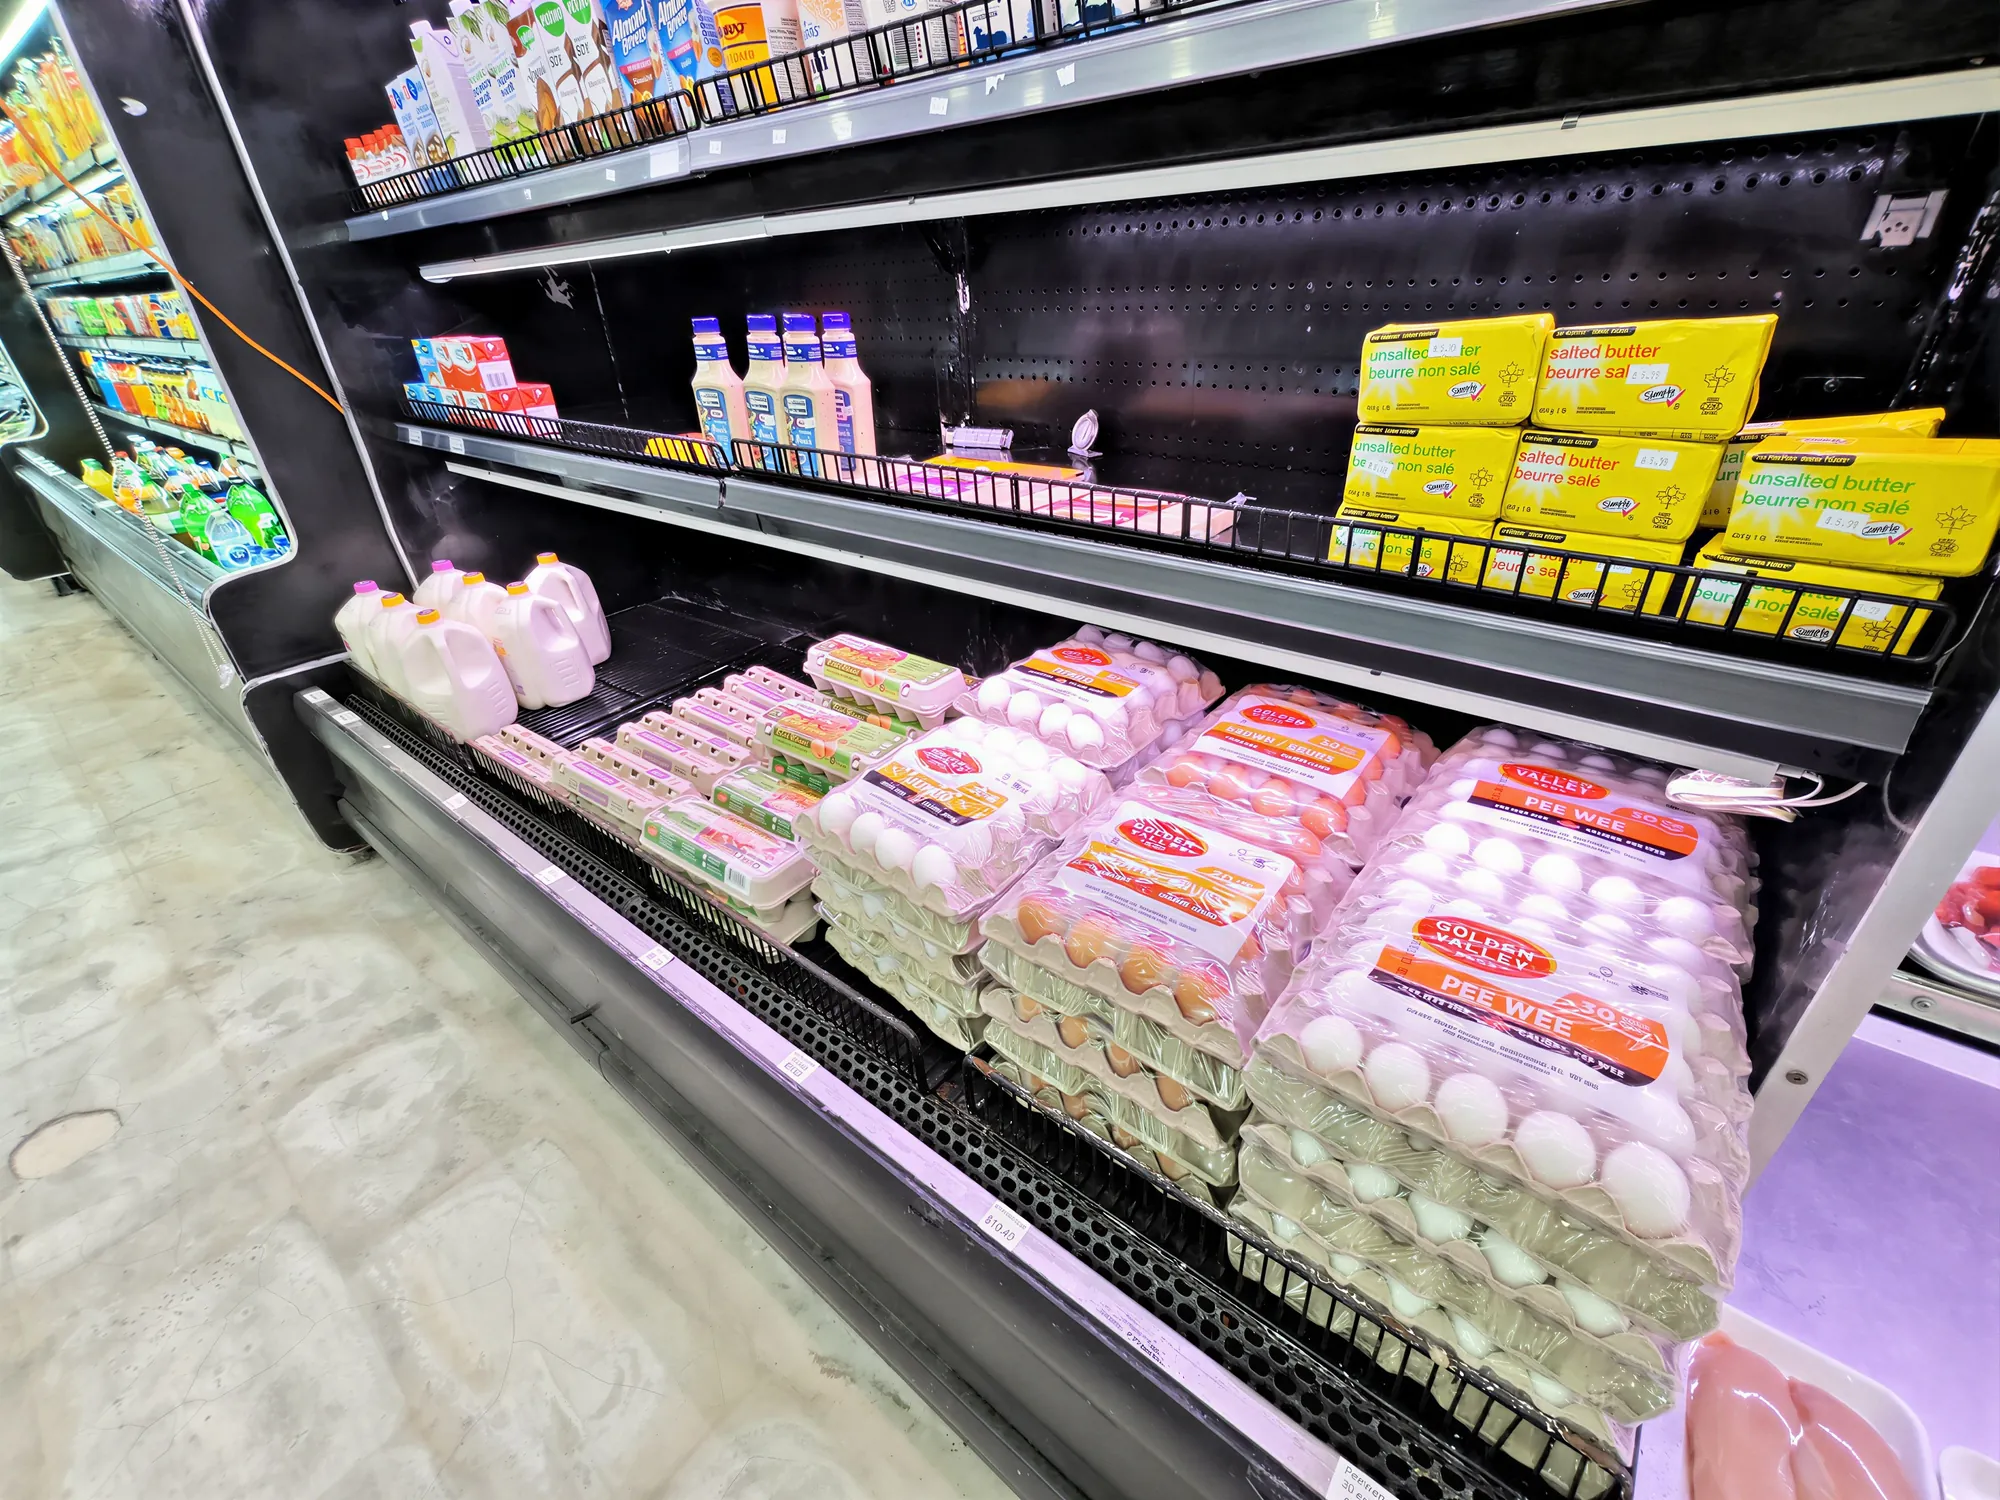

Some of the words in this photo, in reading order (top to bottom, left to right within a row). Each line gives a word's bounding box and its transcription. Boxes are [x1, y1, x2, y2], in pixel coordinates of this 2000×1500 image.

[1550, 344, 1601, 360] salted
[1605, 344, 1660, 359] butter
[1368, 366, 1414, 380] beurre
[1418, 367, 1446, 378] non
[1450, 362, 1481, 376] salé
[1545, 365, 1600, 379] beurre
[1605, 364, 1631, 379] sal
[1354, 441, 1411, 455] unsalted
[1413, 443, 1456, 458] butter
[1397, 461, 1423, 472] non
[1426, 462, 1455, 475] salé
[1518, 450, 1566, 466] salted
[1568, 454, 1620, 471] butter
[1514, 467, 1564, 483] beurre
[1567, 474, 1601, 488] salé
[1749, 473, 1839, 490] unsalted
[1843, 475, 1916, 494] butter
[1741, 491, 1809, 509] beurre
[1815, 498, 1857, 512] non
[1862, 498, 1911, 515] salé
[1796, 604, 1840, 622] salé
[1516, 768, 1593, 795] VALLEY
[1524, 795, 1567, 816] PEE
[1574, 808, 1627, 833] WEE
[1436, 920, 1534, 962] GOLDEN
[1436, 932, 1529, 971] VALLEY
[1440, 974, 1494, 1008] PEE
[1505, 997, 1573, 1038] WEE
[1580, 999, 1616, 1023] 30
